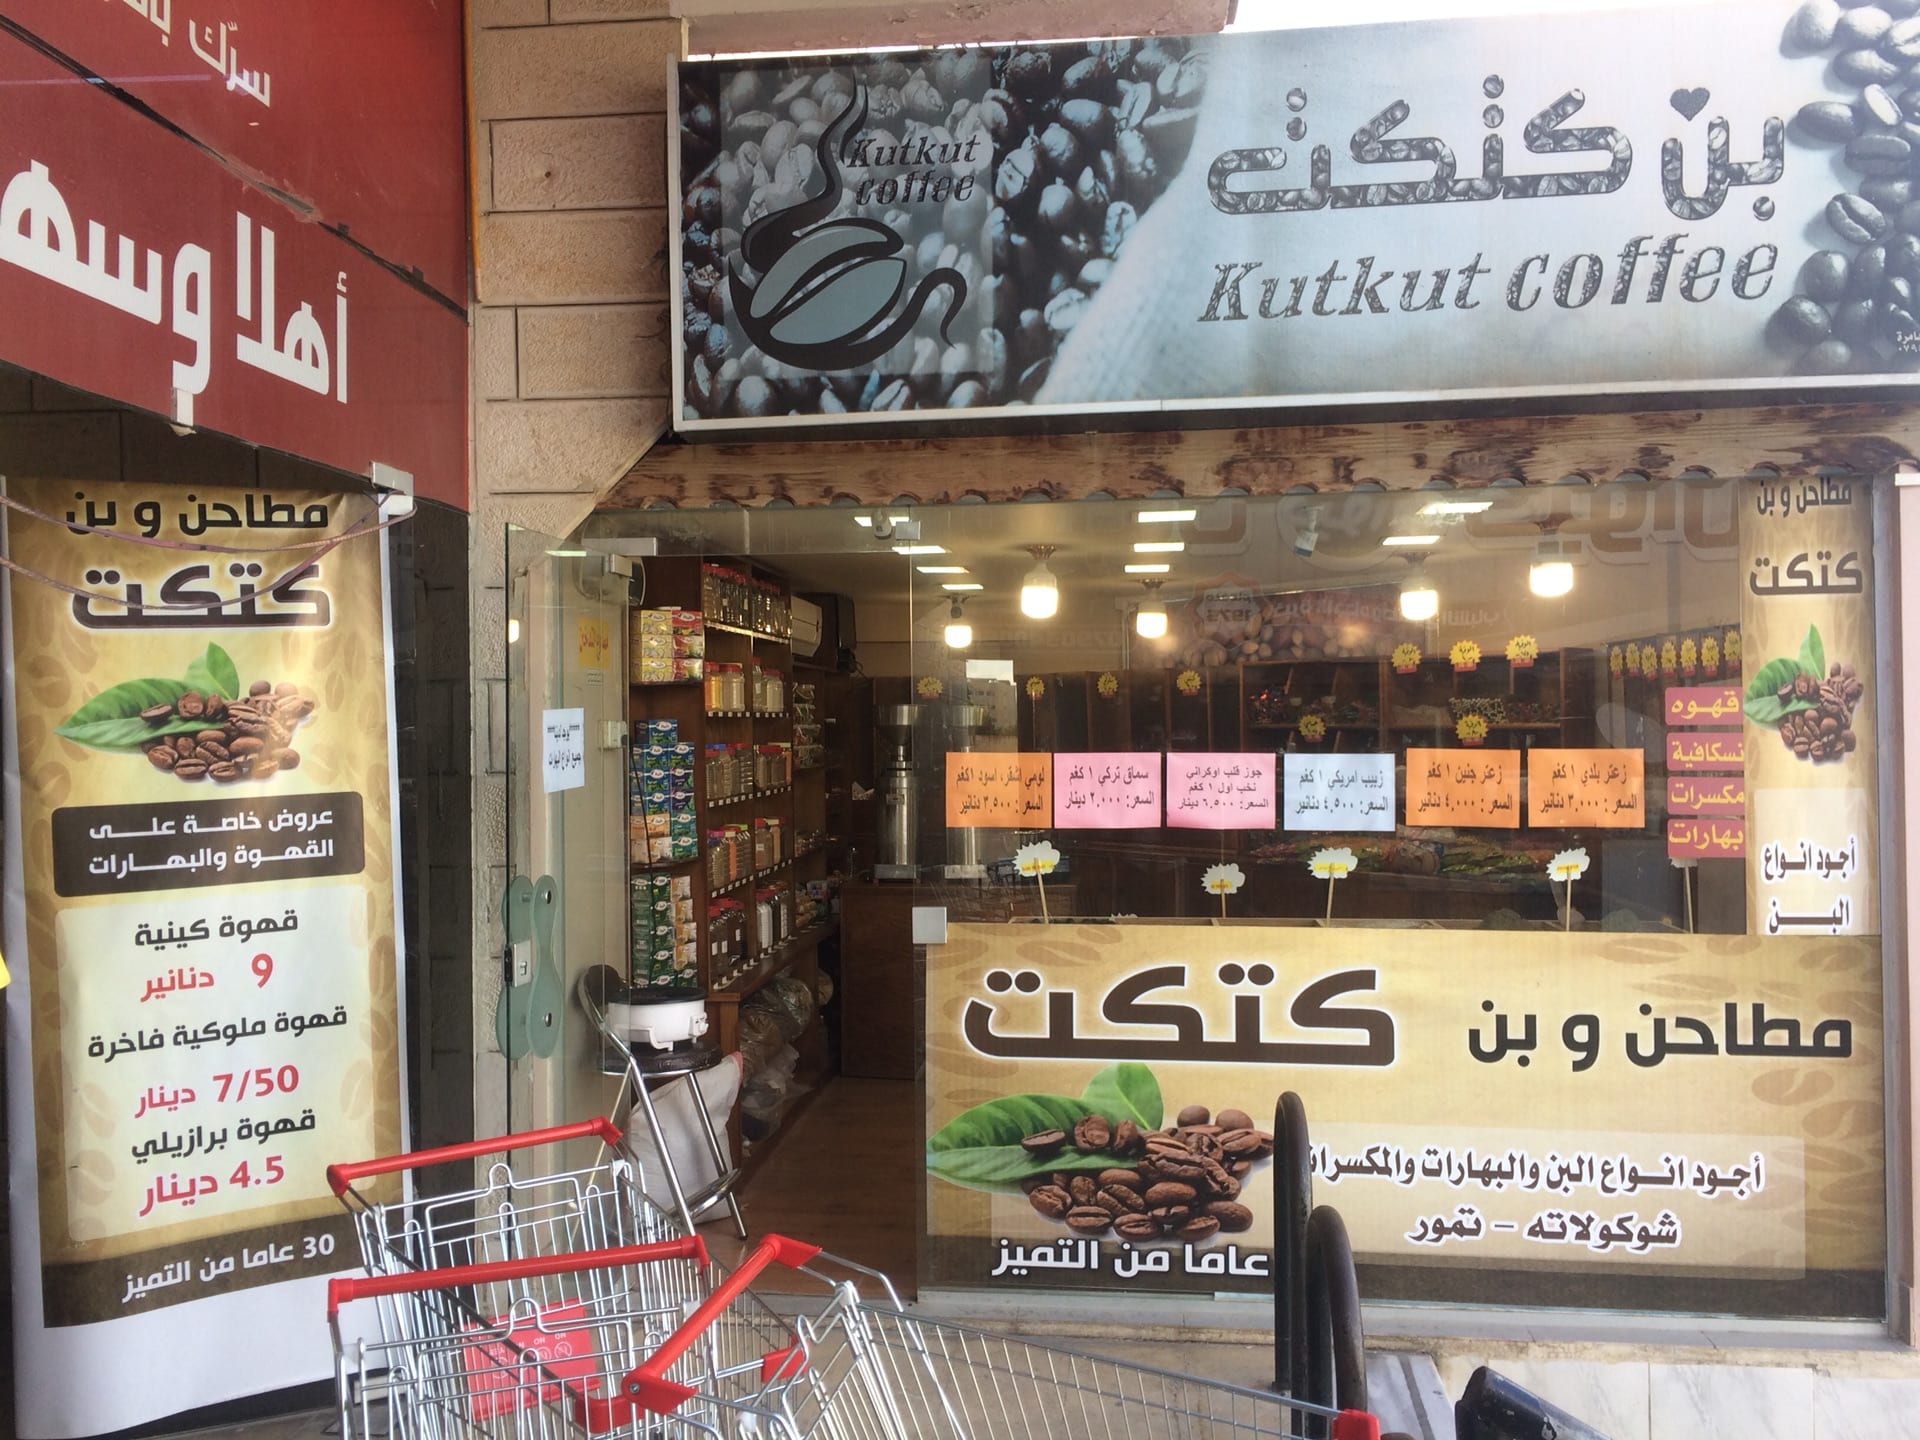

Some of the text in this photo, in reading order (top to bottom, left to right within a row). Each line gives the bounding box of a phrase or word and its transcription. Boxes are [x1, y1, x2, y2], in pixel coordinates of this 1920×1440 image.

[847, 132, 981, 169] Kutkut
[856, 171, 975, 207] coffee
[1198, 233, 1780, 322] Kutkut coffee
[237, 211, 347, 403] أهلا
[66, 491, 329, 538] مطاحن و بن
[1757, 477, 1852, 518] مطاحن و بن
[1749, 550, 1863, 596] كتكت
[73, 563, 332, 630] كتكت
[1671, 691, 1740, 720] قهوه
[1098, 766, 1120, 787] تركي
[1123, 765, 1149, 785] سماق
[1361, 770, 1383, 788] زبيب
[1065, 791, 1086, 809] دينار
[1671, 783, 1745, 810] مكسرات
[89, 809, 334, 841] عروض خاصة على
[1668, 822, 1744, 850] بهارات
[89, 839, 334, 879] القهوة والبهارات
[1764, 838, 1856, 881] أجود انواع
[134, 909, 298, 951] قهوة كينية
[1769, 897, 1849, 935] البن
[140, 953, 274, 1002] 9 دنانير
[88, 1005, 347, 1063] قهوة ملوكية فاخرة
[965, 963, 1396, 1066] كتكت
[1468, 1000, 1852, 1072] مطاحن و بن
[134, 1064, 300, 1118] 7/50 دينار
[132, 1108, 316, 1165] قهوة برازيلي
[139, 1156, 285, 1216] 4.5 دينار
[1421, 1149, 1540, 1189] والبهارات
[1546, 1155, 1593, 1193] البن
[1601, 1156, 1684, 1193] انواع
[1693, 1154, 1763, 1199] أجود
[1408, 1206, 1483, 1241] تمور
[1527, 1211, 1678, 1248] شوكولاته
[122, 1233, 335, 1304] 30 عاما من التميز
[992, 1239, 1269, 1278] عاما من التميز
